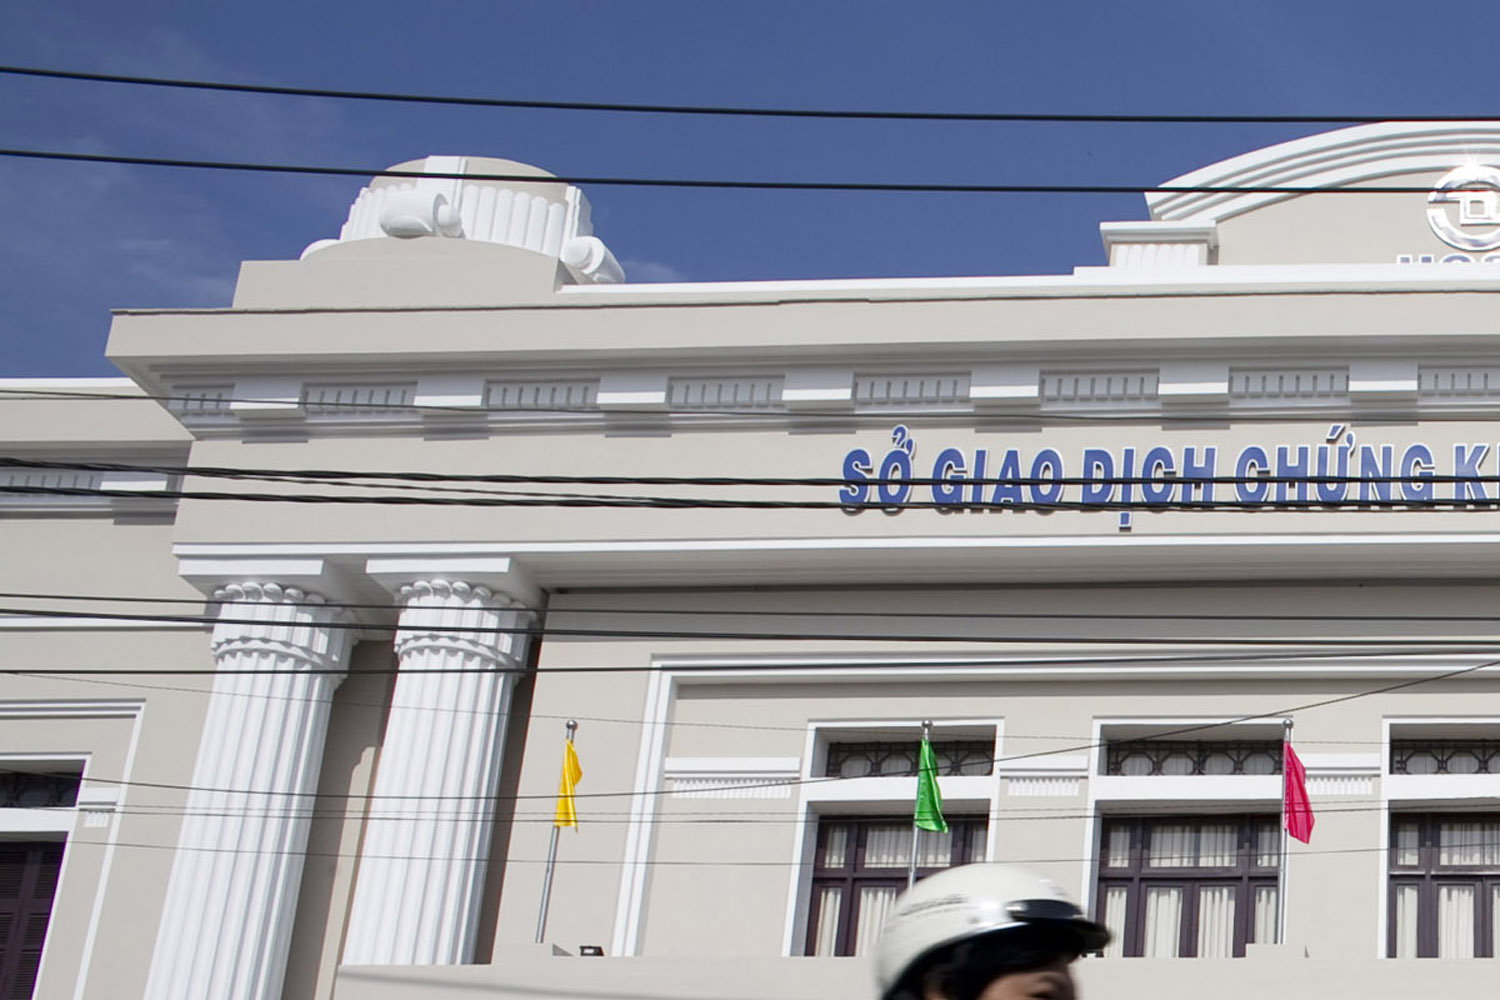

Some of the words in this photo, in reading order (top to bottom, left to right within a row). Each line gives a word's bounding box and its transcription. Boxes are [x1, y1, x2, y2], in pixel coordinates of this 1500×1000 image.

[839, 425, 916, 512] SỞ
[931, 447, 1064, 511] GIAO
[1081, 445, 1217, 530] DỊCH
[1234, 424, 1435, 509] CHỨNG
